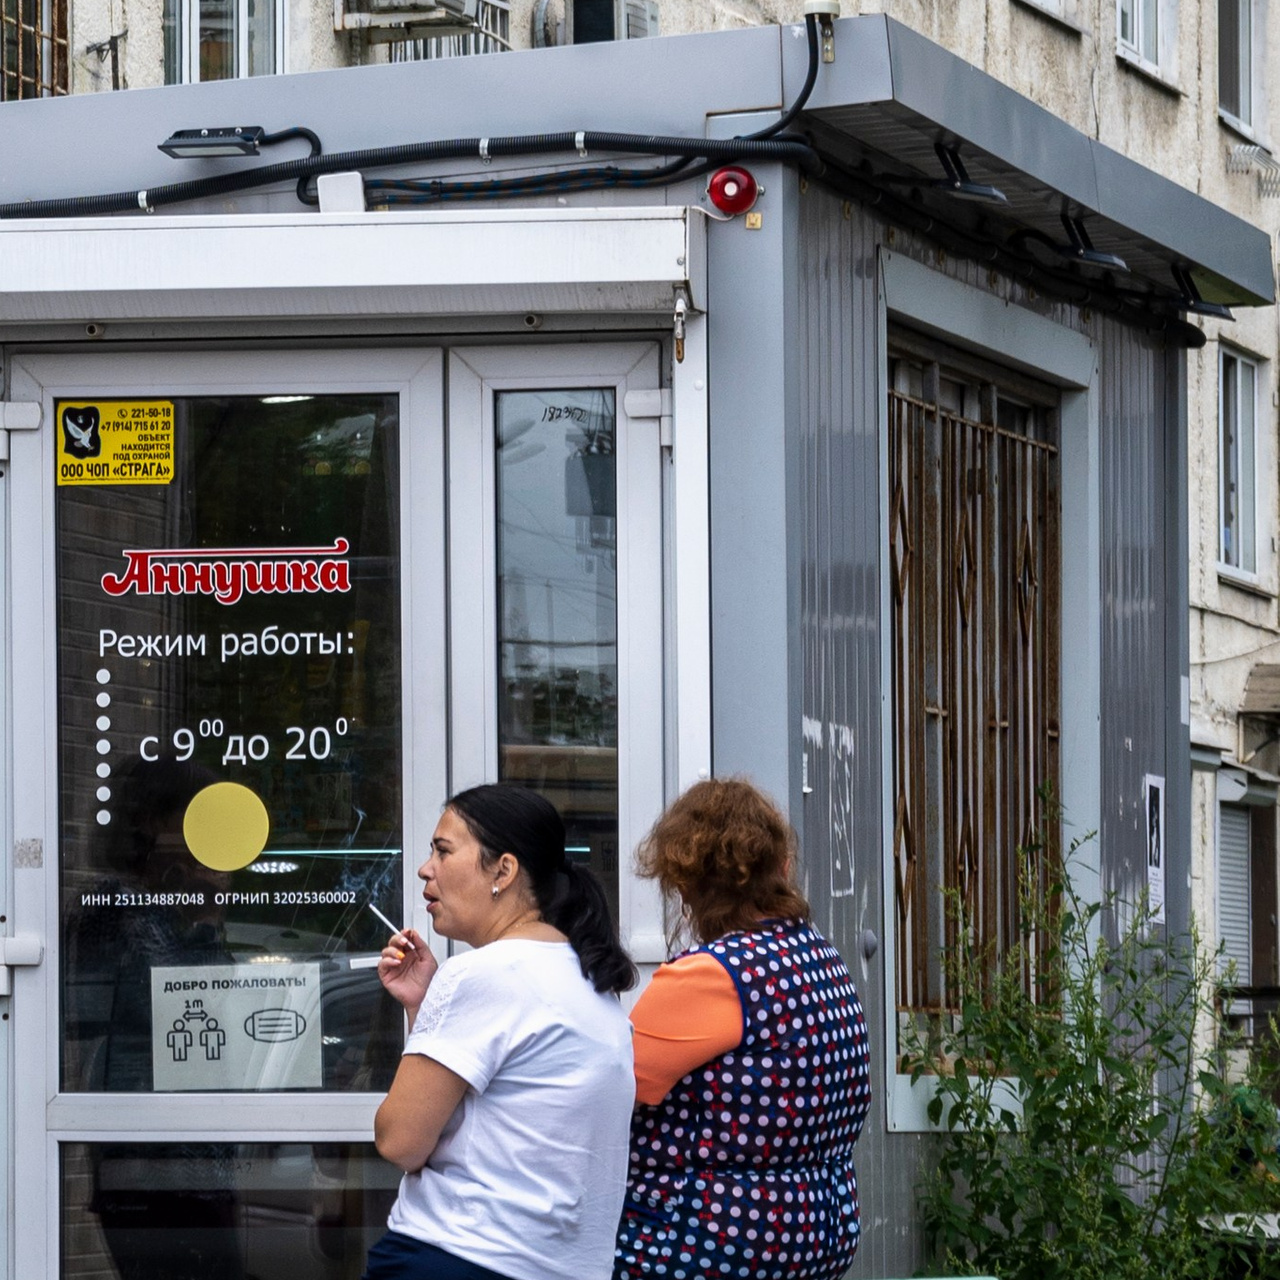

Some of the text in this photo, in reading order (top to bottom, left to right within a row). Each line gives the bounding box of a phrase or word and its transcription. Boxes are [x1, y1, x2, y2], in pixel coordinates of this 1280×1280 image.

[131, 408, 171, 418] 221-50-18
[100, 421, 171, 431] +7 (914) 715 61 20
[121, 443, 171, 451] НАХОДИТСЯ
[112, 451, 171, 461] ПОД ОХРАНОЙ
[61, 462, 171, 477] ООО ЧОП «СТРАГА»
[101, 537, 352, 605] Аннушка
[98, 625, 355, 663] Режим работы:
[222, 734, 270, 766] до
[81, 891, 357, 906] ИНН 251134887048 ОГРНИП 32025360002
[164, 977, 307, 993] ДОБРО ПОЖАЛОВАТЬ!
